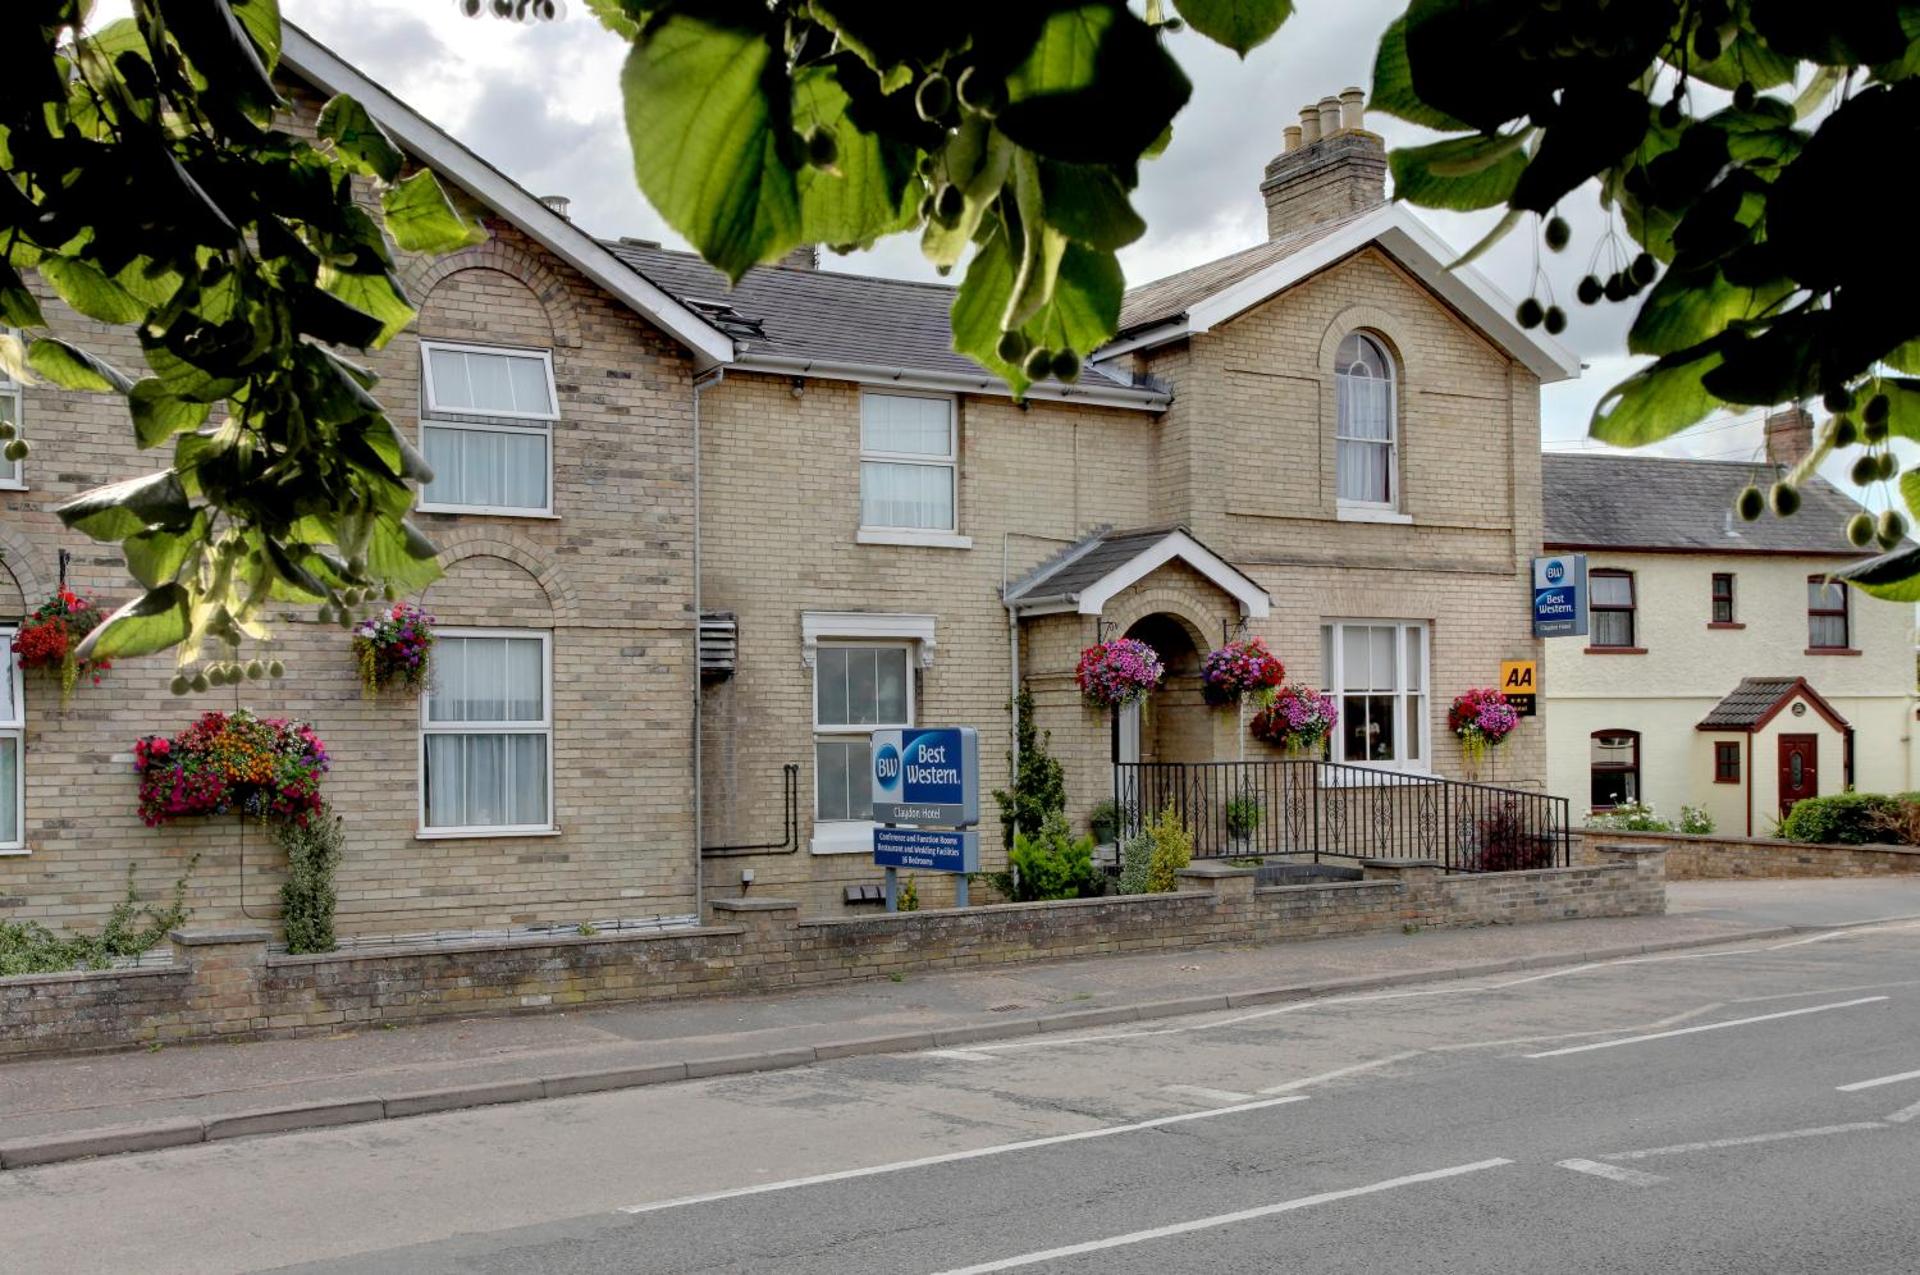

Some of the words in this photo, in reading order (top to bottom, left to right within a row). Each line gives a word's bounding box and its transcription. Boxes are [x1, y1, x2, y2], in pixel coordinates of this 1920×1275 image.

[1546, 594, 1564, 604] Best
[1505, 667, 1532, 687] AA
[918, 744, 945, 764] Best
[878, 758, 898, 777] BW
[922, 808, 940, 819] Hotel
[906, 834, 916, 842] and
[904, 845, 914, 853] and
